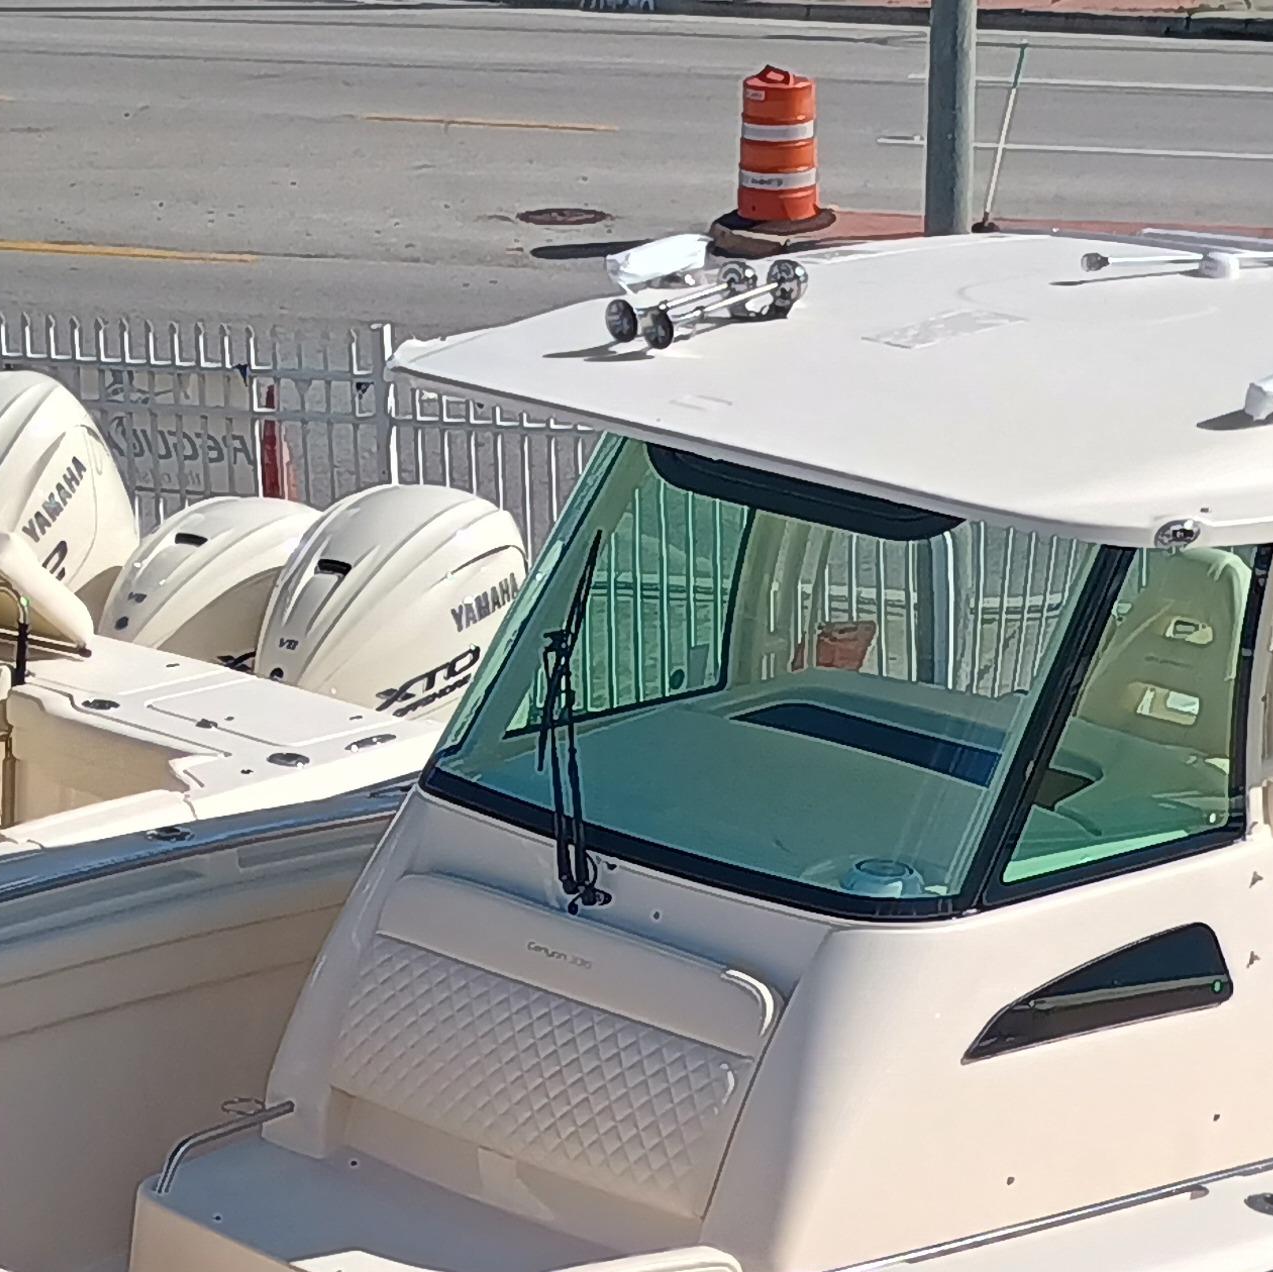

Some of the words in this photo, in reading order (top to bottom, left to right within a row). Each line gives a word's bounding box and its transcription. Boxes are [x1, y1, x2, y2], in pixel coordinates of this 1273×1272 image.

[22, 456, 87, 543] YAMAHA
[451, 572, 520, 633] YAMAHA
[376, 645, 481, 712] XTO
